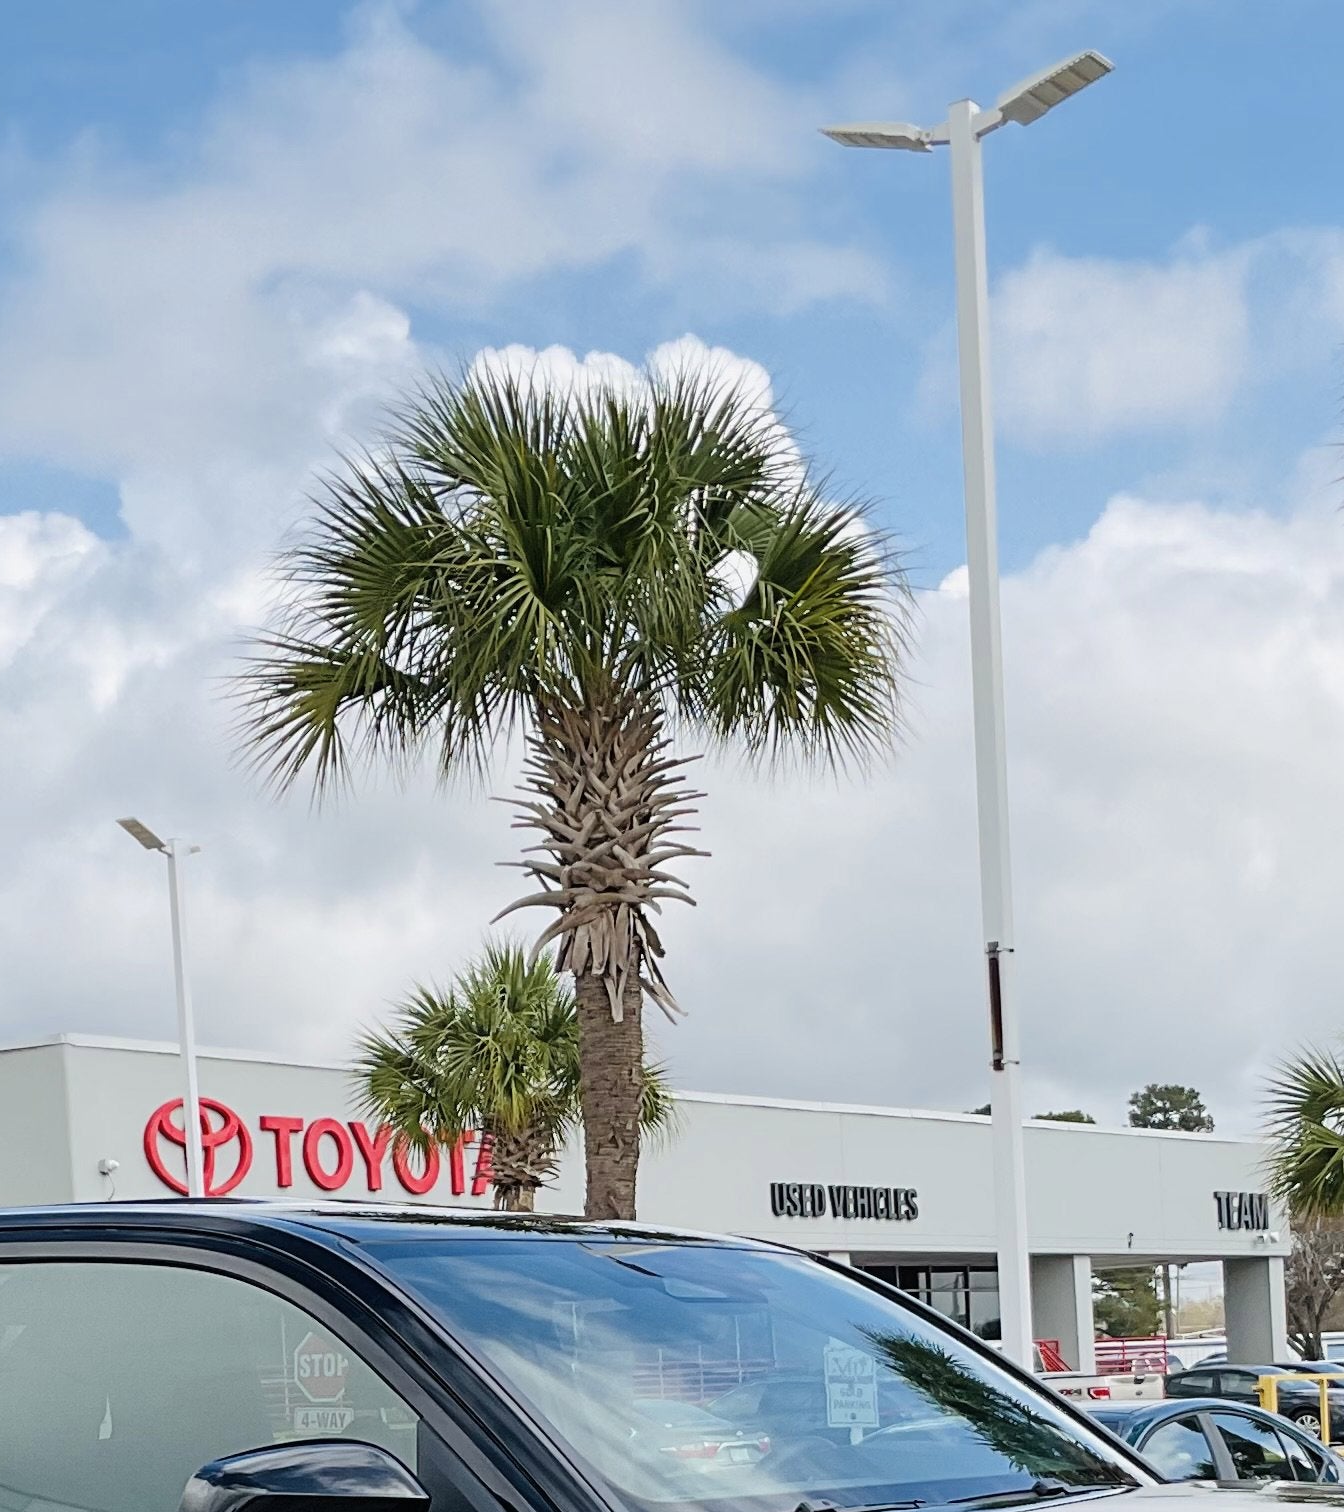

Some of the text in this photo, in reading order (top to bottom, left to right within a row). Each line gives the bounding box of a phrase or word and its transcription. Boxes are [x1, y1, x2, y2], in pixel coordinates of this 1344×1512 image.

[770, 1182, 918, 1220] USED VEHICLES
[1213, 1191, 1269, 1230] TEAM
[299, 1353, 349, 1378] STOP
[300, 1411, 348, 1429] 4-WAY
